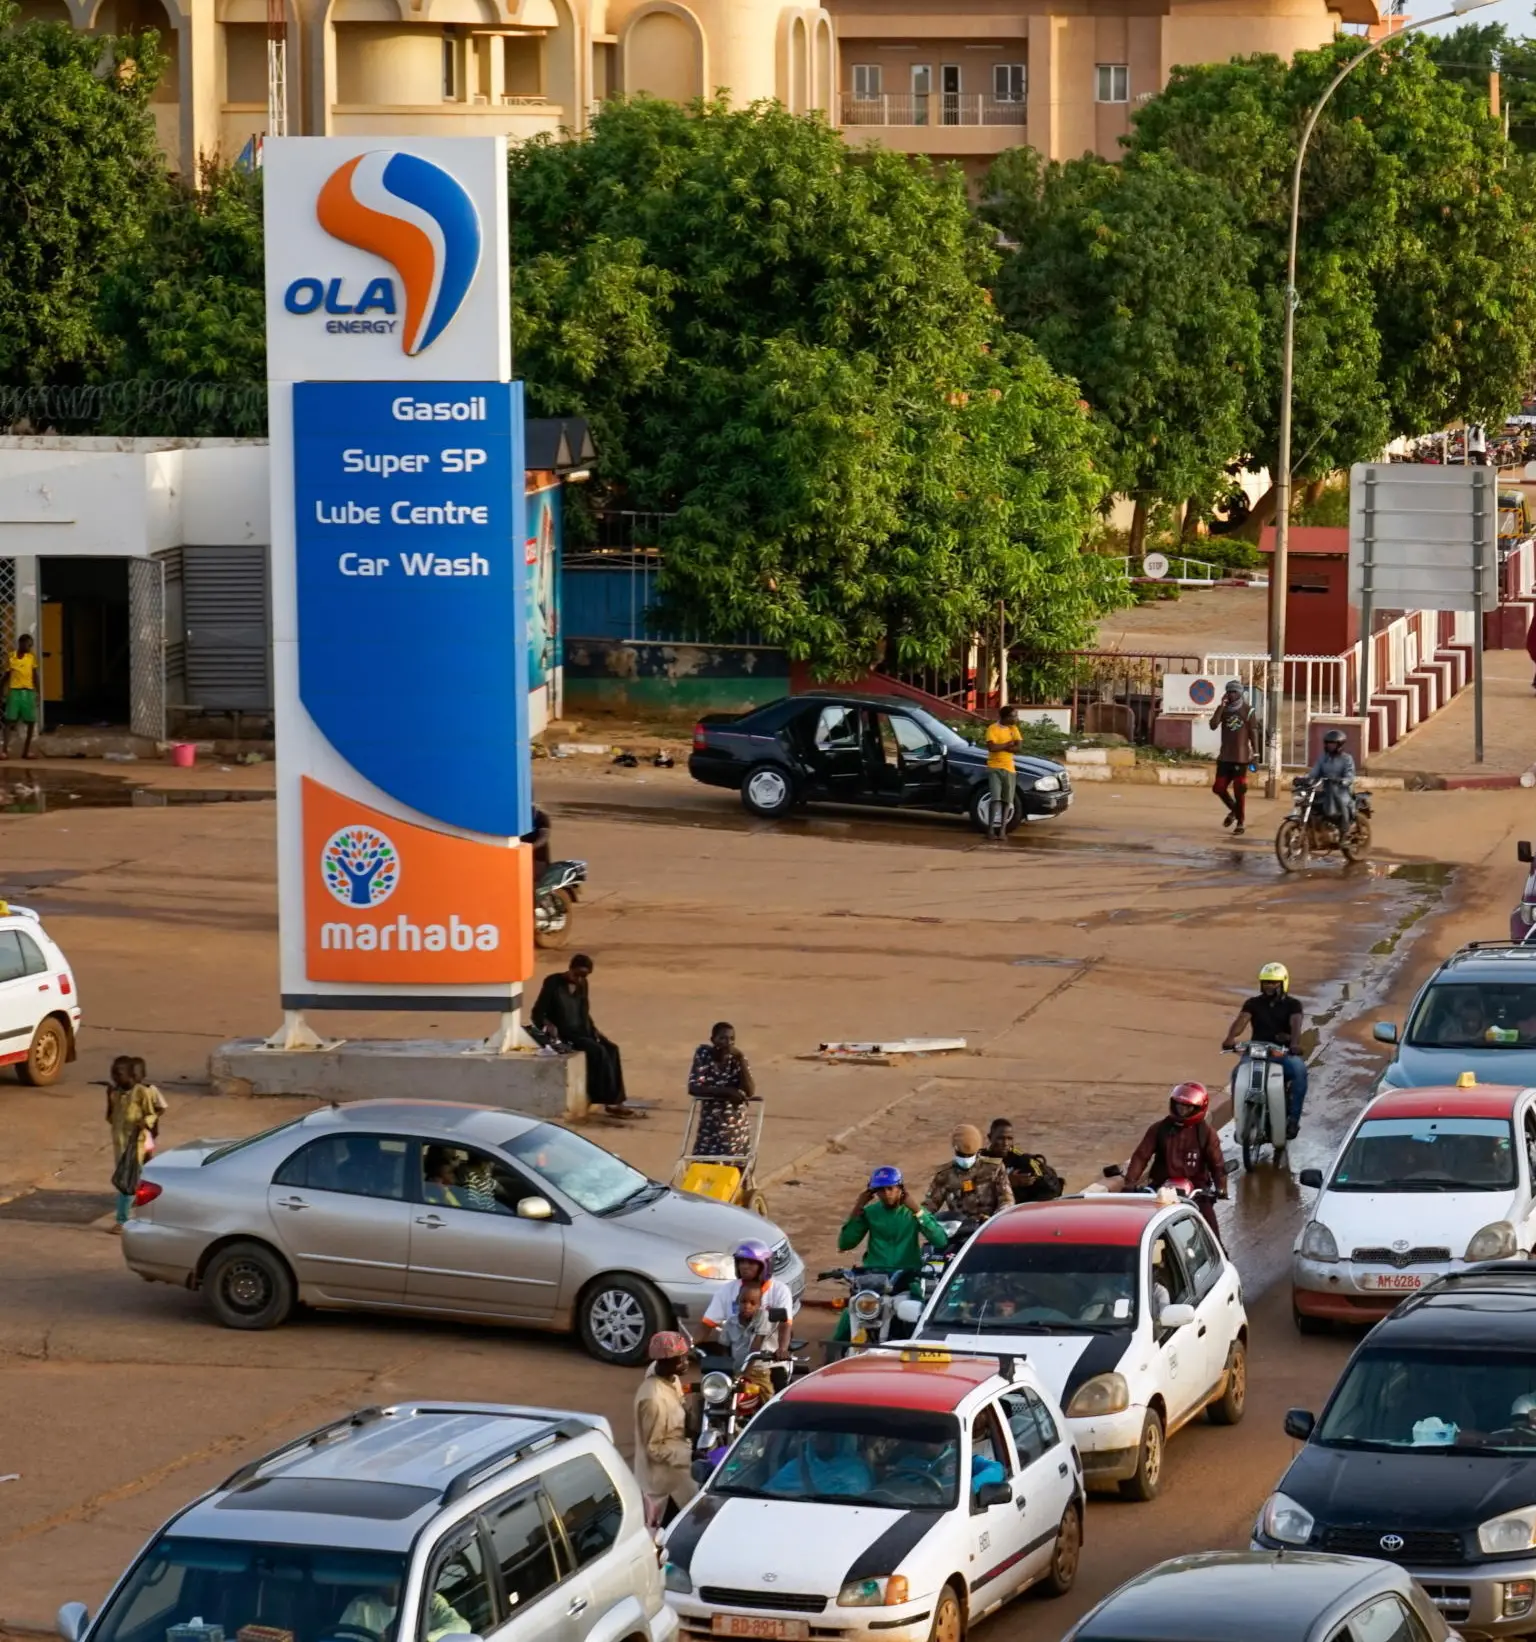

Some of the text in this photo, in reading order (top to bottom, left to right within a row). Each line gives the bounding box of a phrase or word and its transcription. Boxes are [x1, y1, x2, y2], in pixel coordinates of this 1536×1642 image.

[284, 277, 397, 315] OLA
[326, 320, 398, 334] ENERGY
[392, 396, 487, 421] Gasoil
[342, 448, 488, 478] Super SP
[315, 500, 489, 524] Lube Centre
[339, 552, 490, 576] Car Wash
[320, 914, 500, 951] marhaba
[1378, 1275, 1421, 1288] AM-6286
